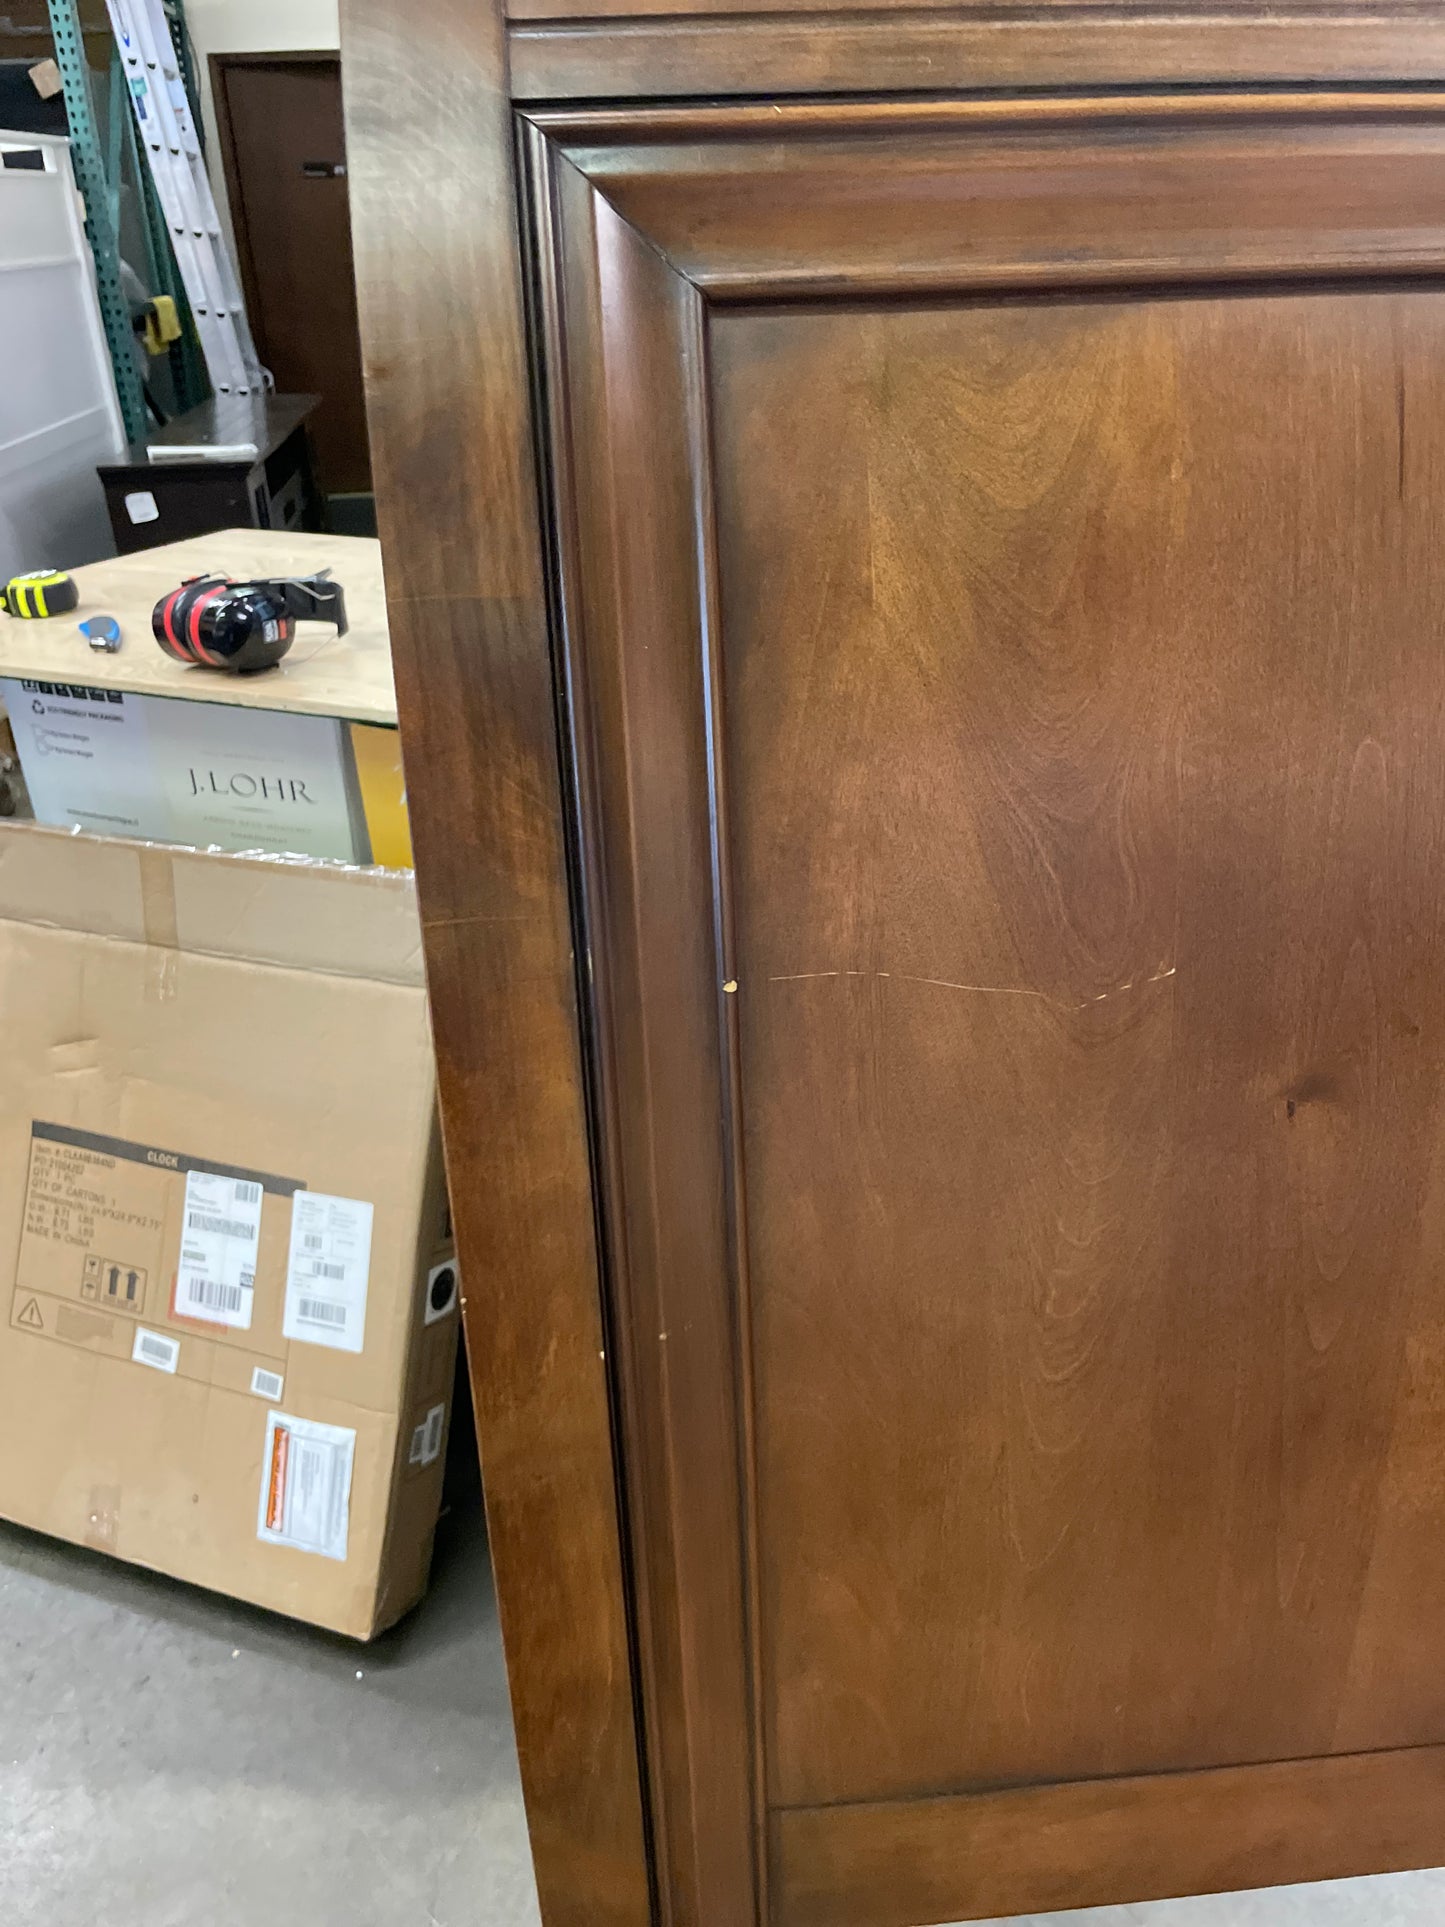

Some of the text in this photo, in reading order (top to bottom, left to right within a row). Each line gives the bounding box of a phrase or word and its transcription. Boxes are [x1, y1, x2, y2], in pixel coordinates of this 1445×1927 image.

[147, 1150, 179, 1168] CLOCK
[26, 1222, 49, 1239] MADE
[52, 1230, 62, 1240] IN
